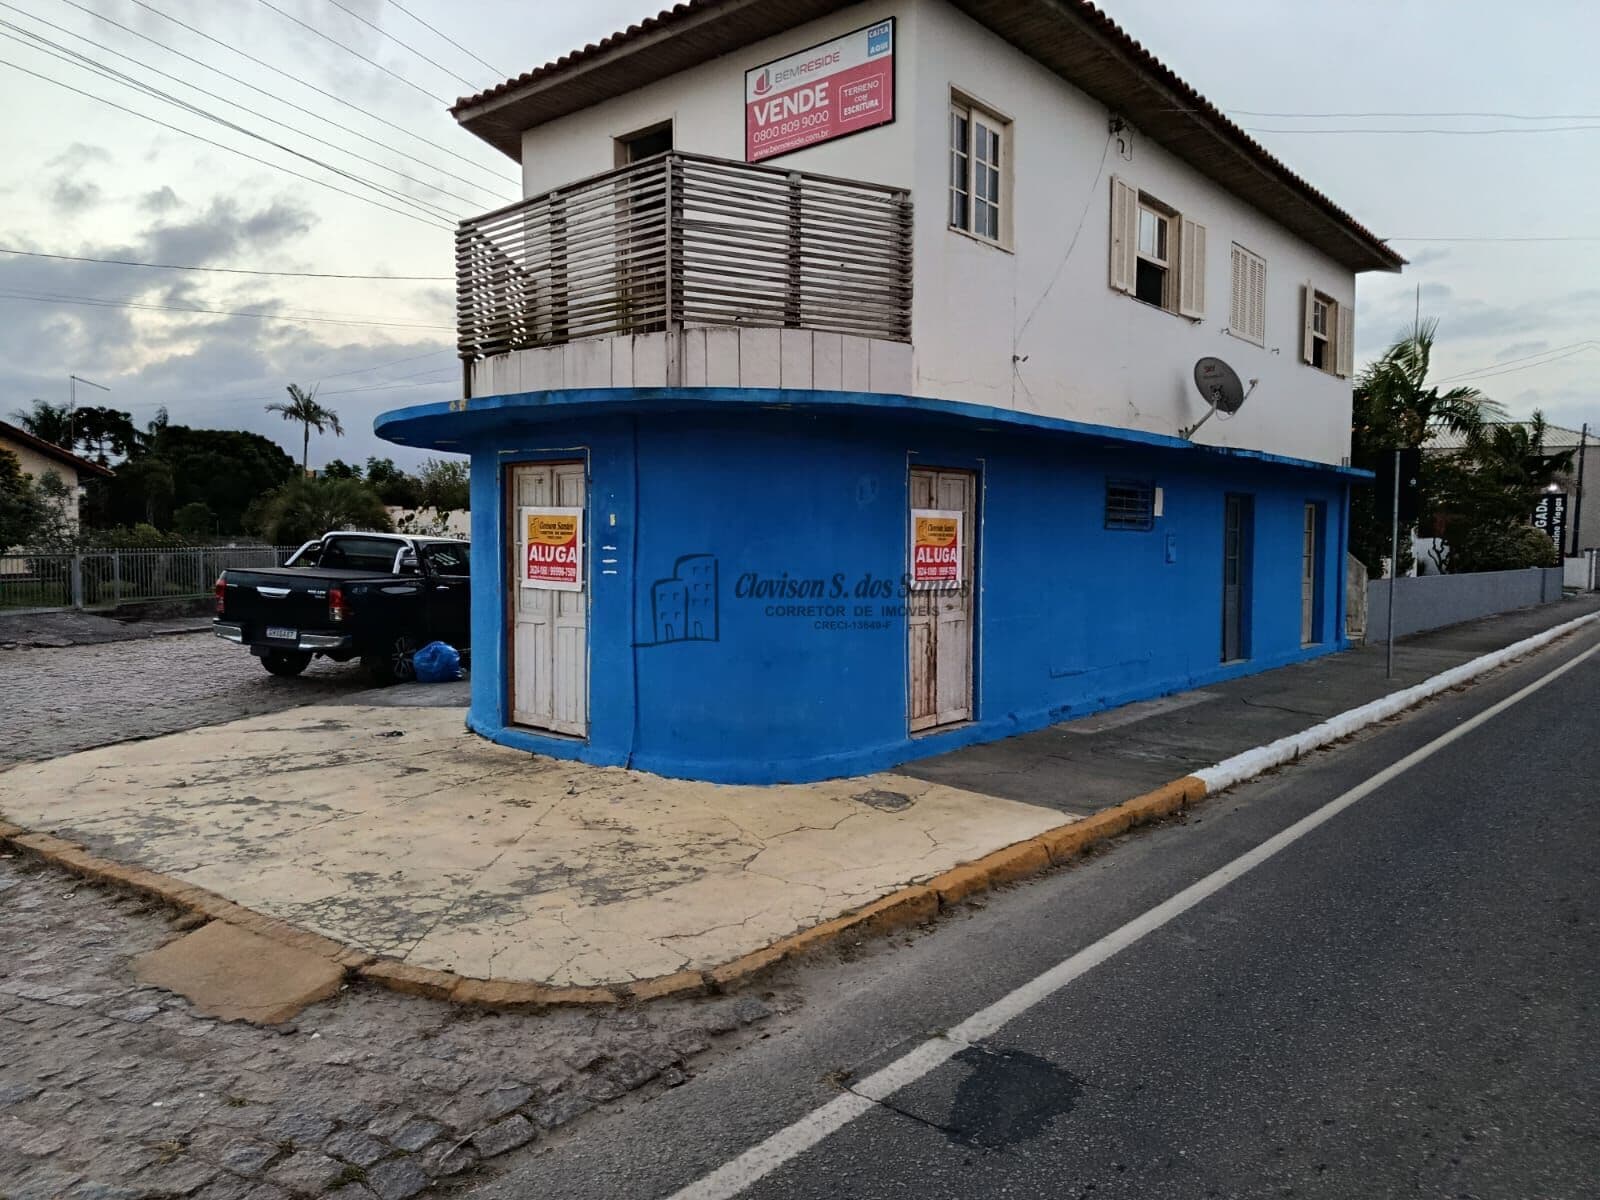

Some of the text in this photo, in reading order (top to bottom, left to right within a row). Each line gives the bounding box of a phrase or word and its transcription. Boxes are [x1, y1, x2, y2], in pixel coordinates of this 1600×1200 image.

[869, 26, 888, 38] CAIXA
[870, 42, 888, 54] AQUI
[775, 51, 840, 83] BEMRESIDE
[843, 80, 879, 97] TERRENO
[753, 81, 829, 126] VENDE
[843, 98, 879, 116] ESCRITURA
[753, 110, 829, 143] 0800 809 9000
[529, 545, 576, 563] ALUGA
[916, 547, 958, 563] ALUGA
